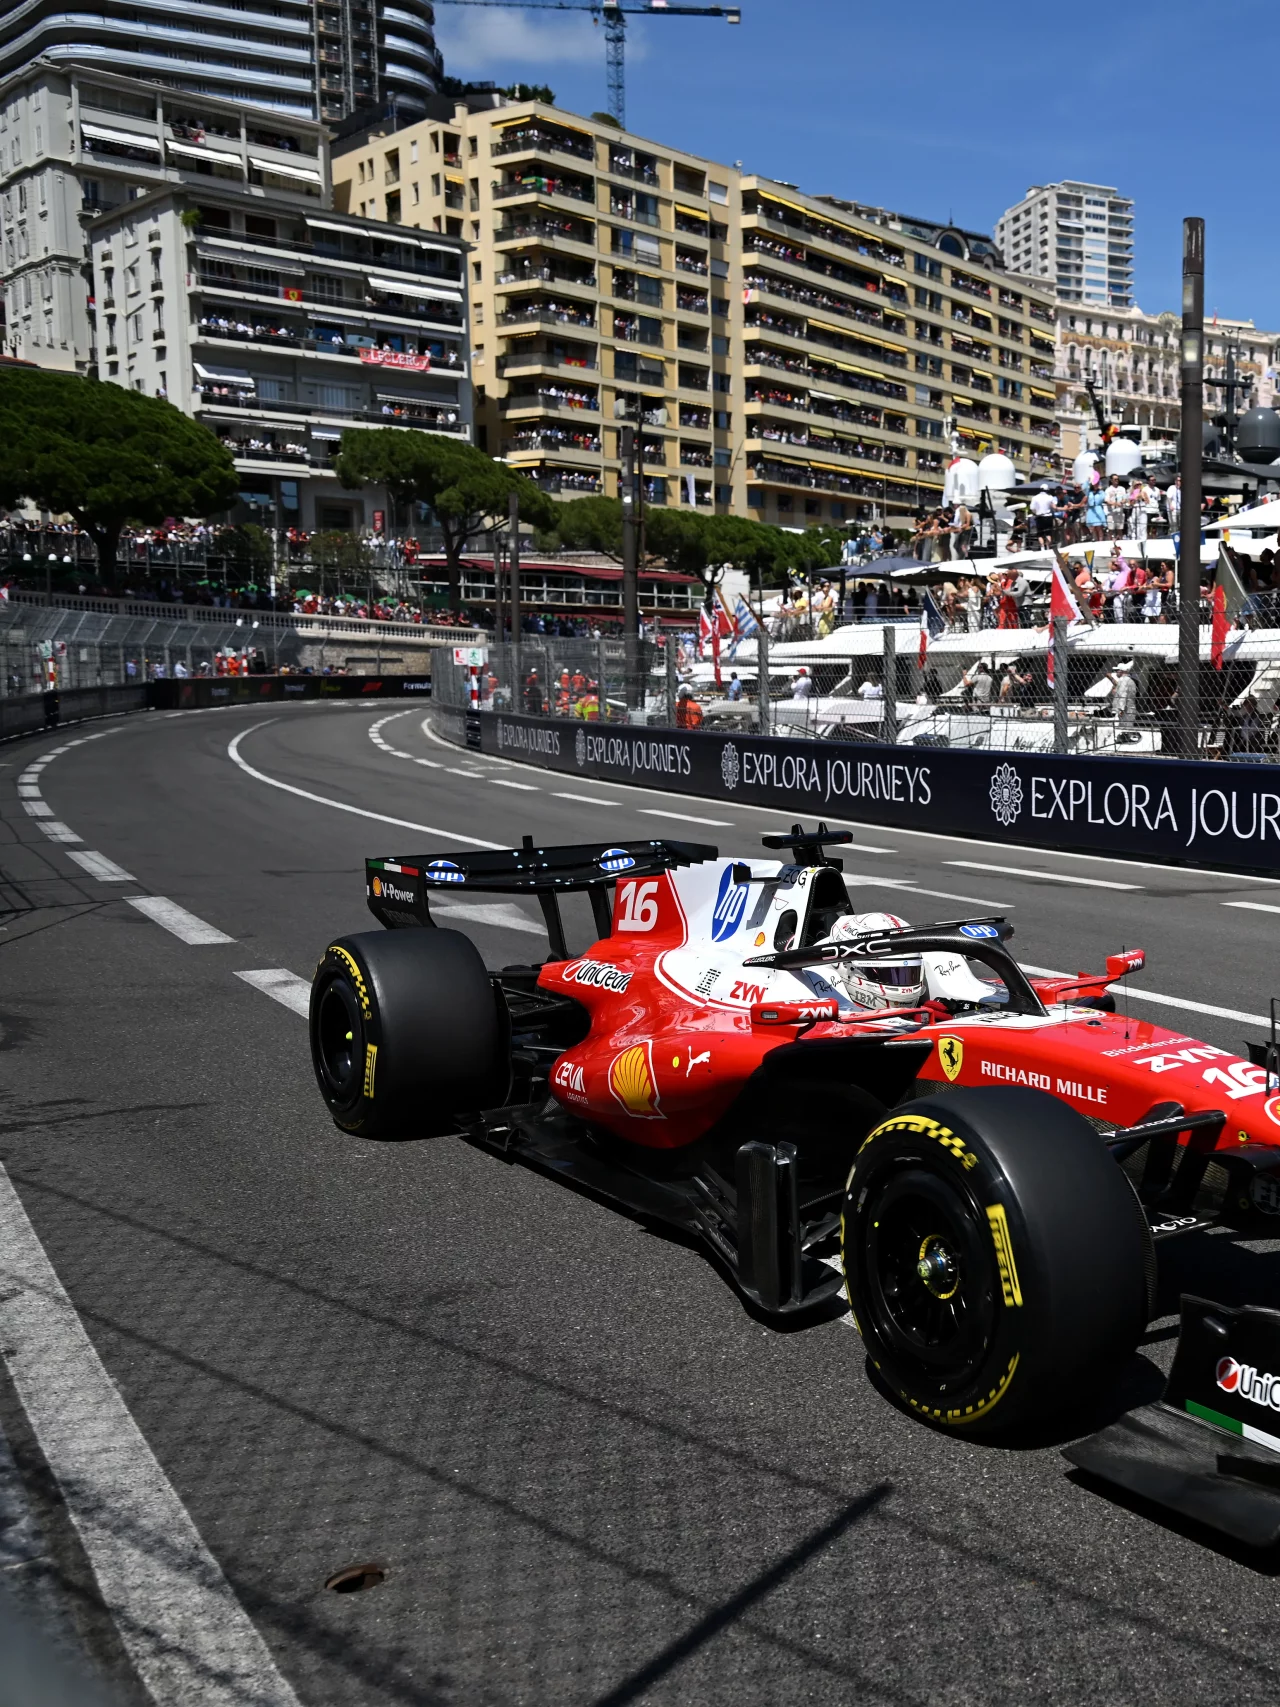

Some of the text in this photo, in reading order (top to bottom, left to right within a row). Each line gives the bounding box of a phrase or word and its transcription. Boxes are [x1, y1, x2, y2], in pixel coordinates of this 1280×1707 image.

[370, 349, 420, 367] LECLERC
[503, 726, 560, 755] EXPLORA JOURNEYS
[586, 736, 691, 775] EXPLORA JOURNEYS
[743, 752, 932, 804] EXPLORA JOURNEYS
[1031, 776, 1178, 832] EXPLORA
[381, 882, 415, 904] V-Power
[618, 881, 659, 932] 16
[821, 939, 893, 961] DXC
[1127, 957, 1143, 971] ZYN
[934, 961, 962, 977] Ray-Ban
[729, 981, 768, 1004] ZYN
[855, 990, 877, 1008] IBM
[797, 1006, 833, 1019] ZYN
[364, 1043, 378, 1098] PIRELLI
[1132, 1045, 1235, 1073] ZYN
[981, 1060, 1107, 1104] RICHARD MILLE
[986, 1203, 1023, 1307] PIRELLI
